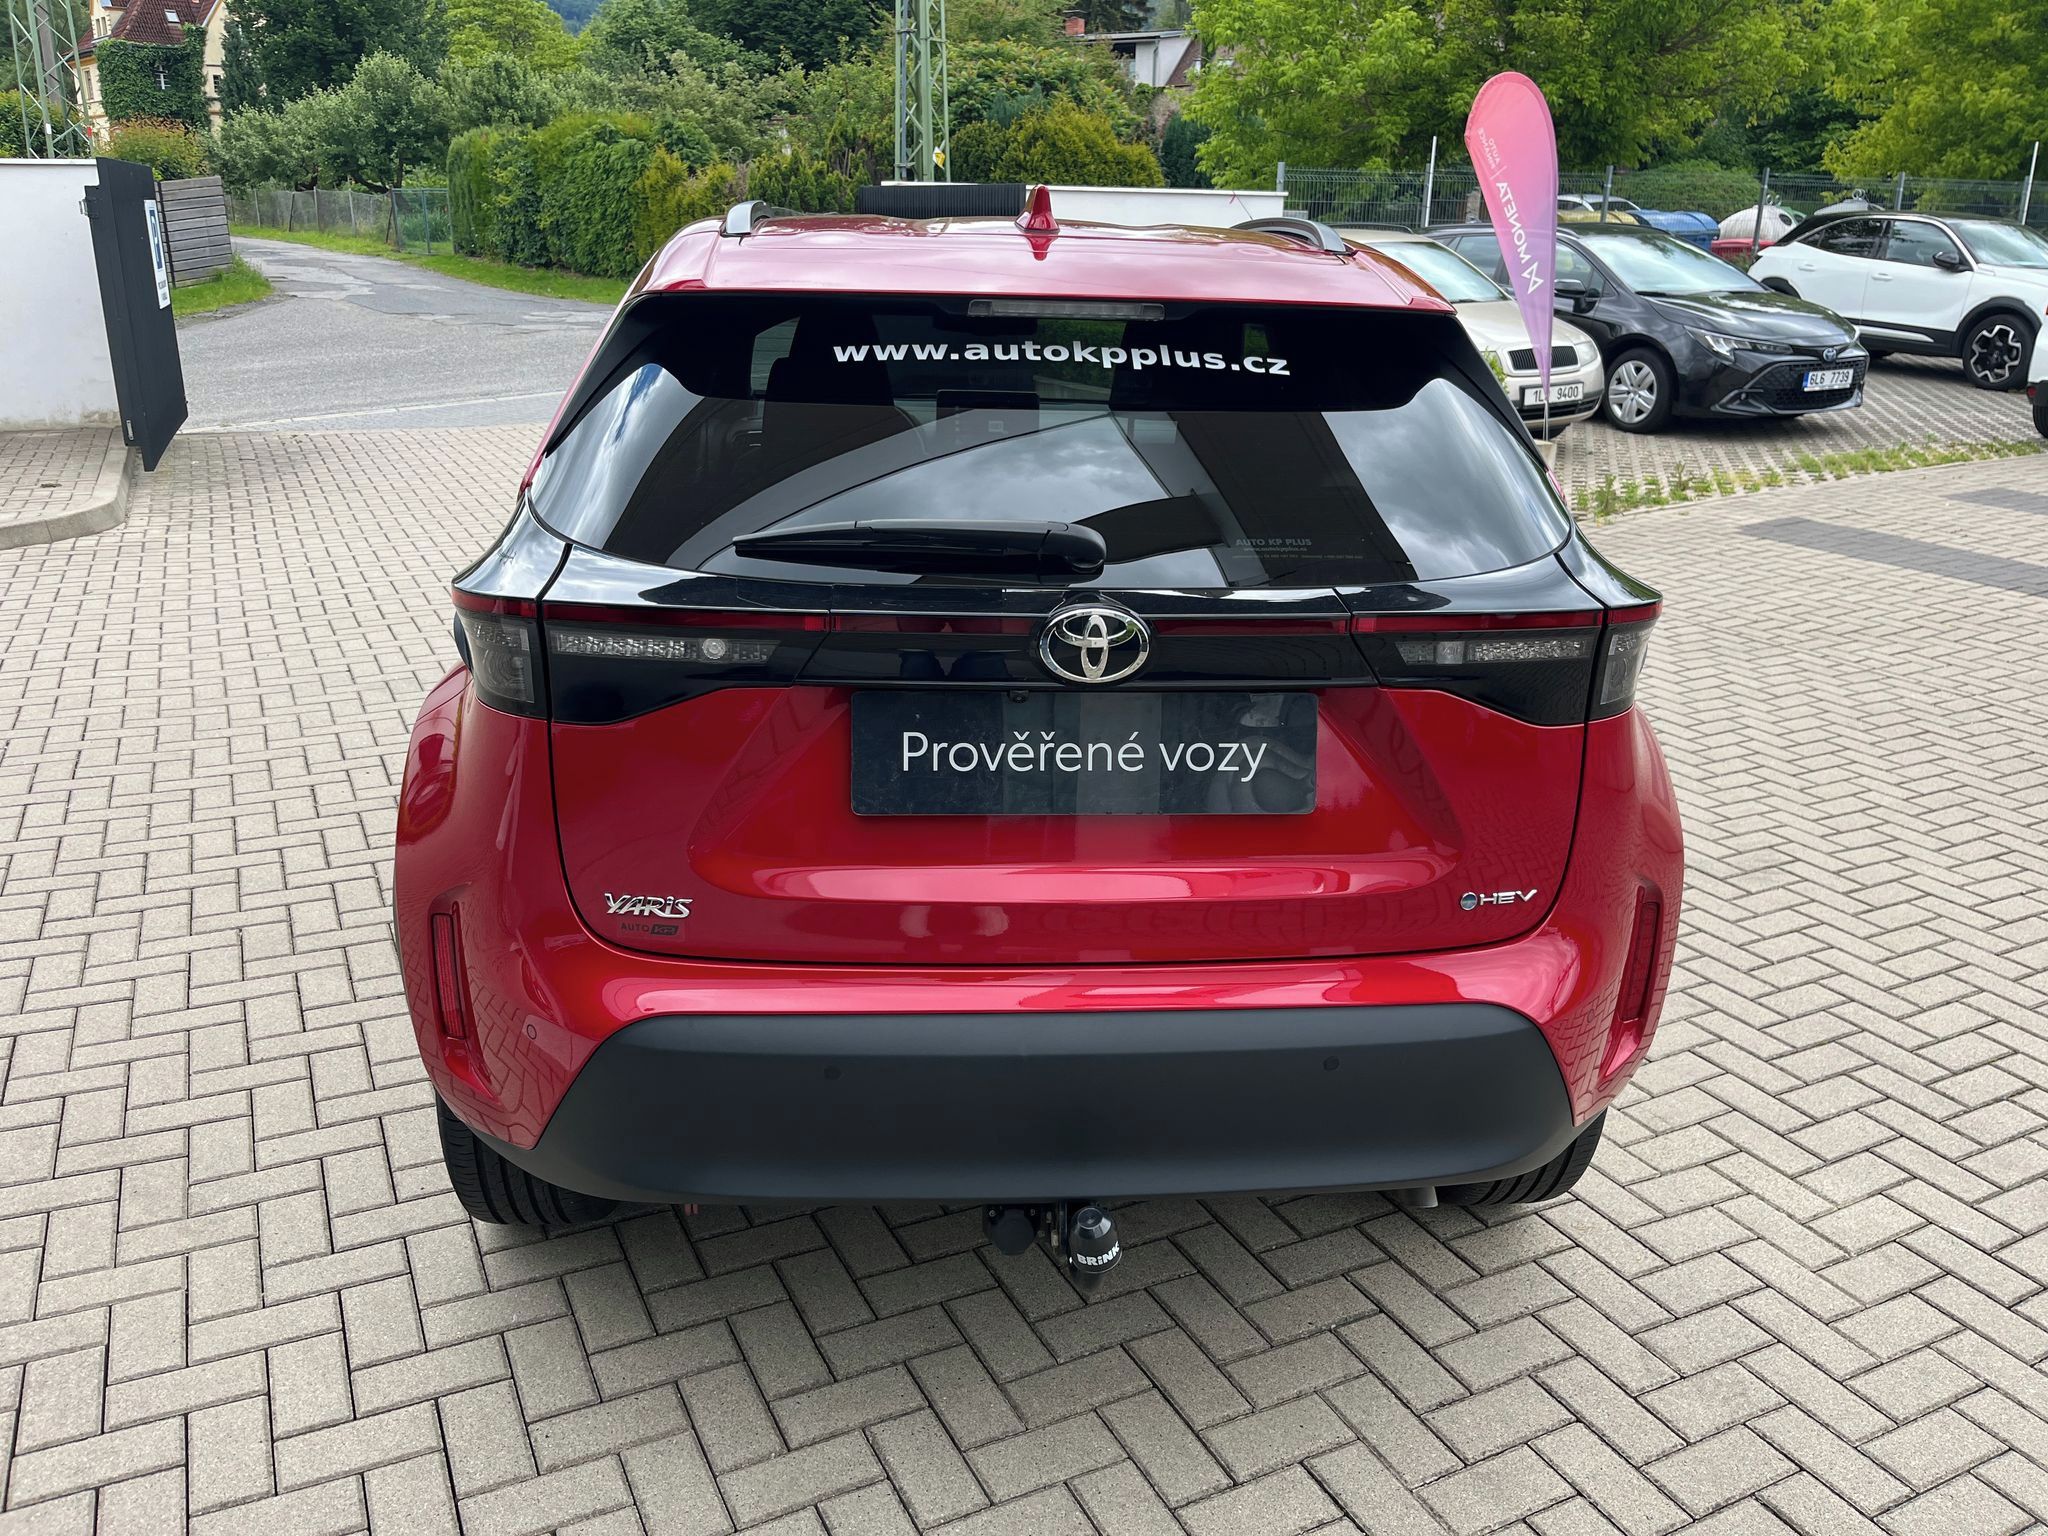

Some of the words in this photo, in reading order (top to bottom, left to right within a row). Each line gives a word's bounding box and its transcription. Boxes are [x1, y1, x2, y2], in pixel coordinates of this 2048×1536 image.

[833, 340, 1291, 376] www.autokpplus.cz
[1809, 372, 1826, 386] 6L6
[1830, 370, 1850, 384] 7739
[1556, 385, 1579, 401] 9400
[1235, 538, 1266, 547] AUTO
[1268, 538, 1283, 547] KP
[1285, 538, 1313, 547] PLUS
[902, 730, 1145, 773] Prověřené
[1158, 742, 1268, 783] vozy
[1479, 888, 1538, 906] HEV
[620, 922, 651, 933] AUTO
